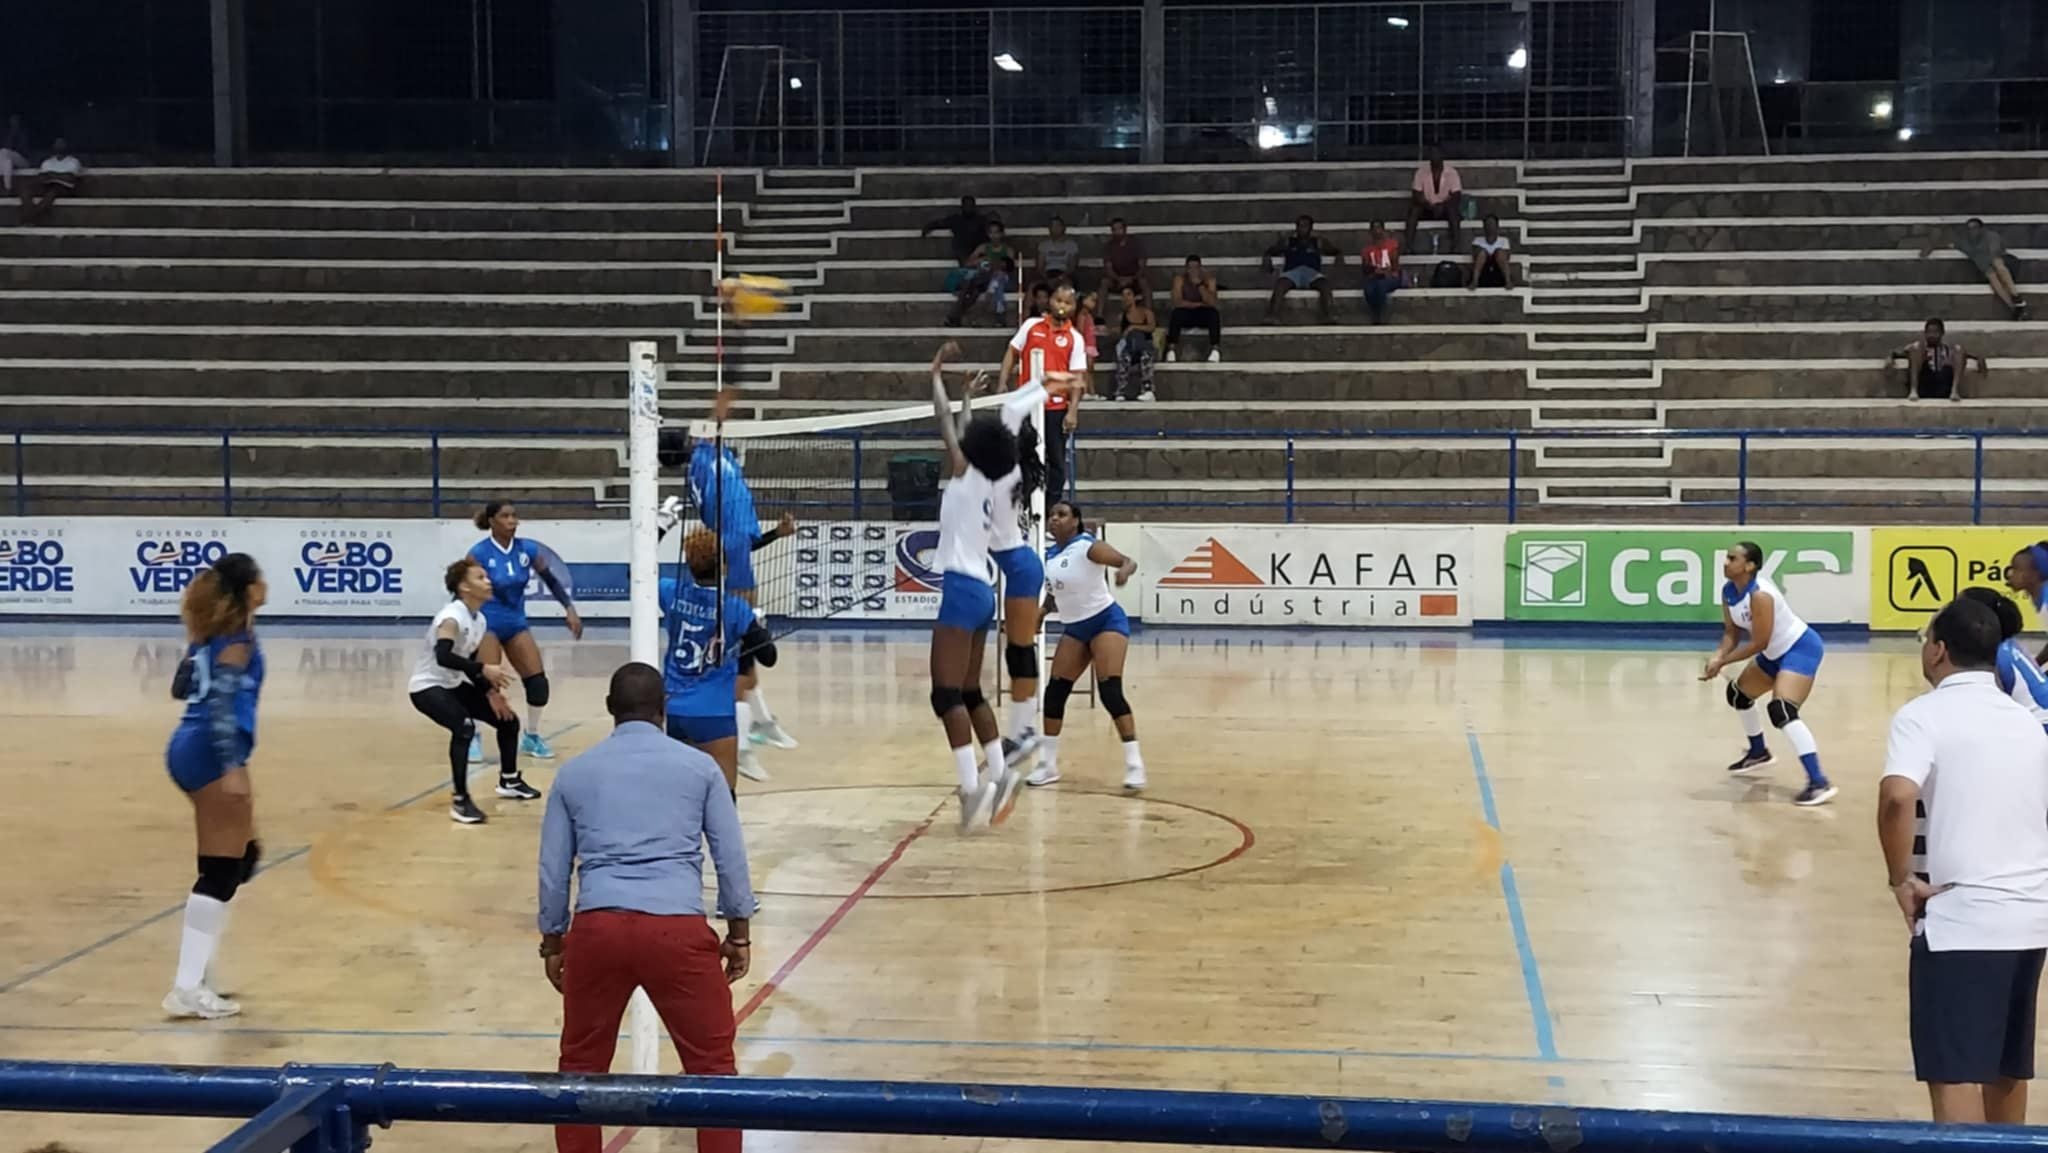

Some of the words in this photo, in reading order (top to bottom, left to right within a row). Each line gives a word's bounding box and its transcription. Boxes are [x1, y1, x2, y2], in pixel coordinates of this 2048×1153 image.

[300, 530, 367, 538] GOVERNO
[376, 530, 392, 538] DE
[137, 541, 228, 567] CABO
[302, 541, 393, 567] CABO
[129, 567, 210, 592] VER
[294, 568, 402, 593] VERDE
[505, 561, 515, 576] 1
[1271, 553, 1458, 586] KAFAR
[1156, 593, 1408, 616] Indústria
